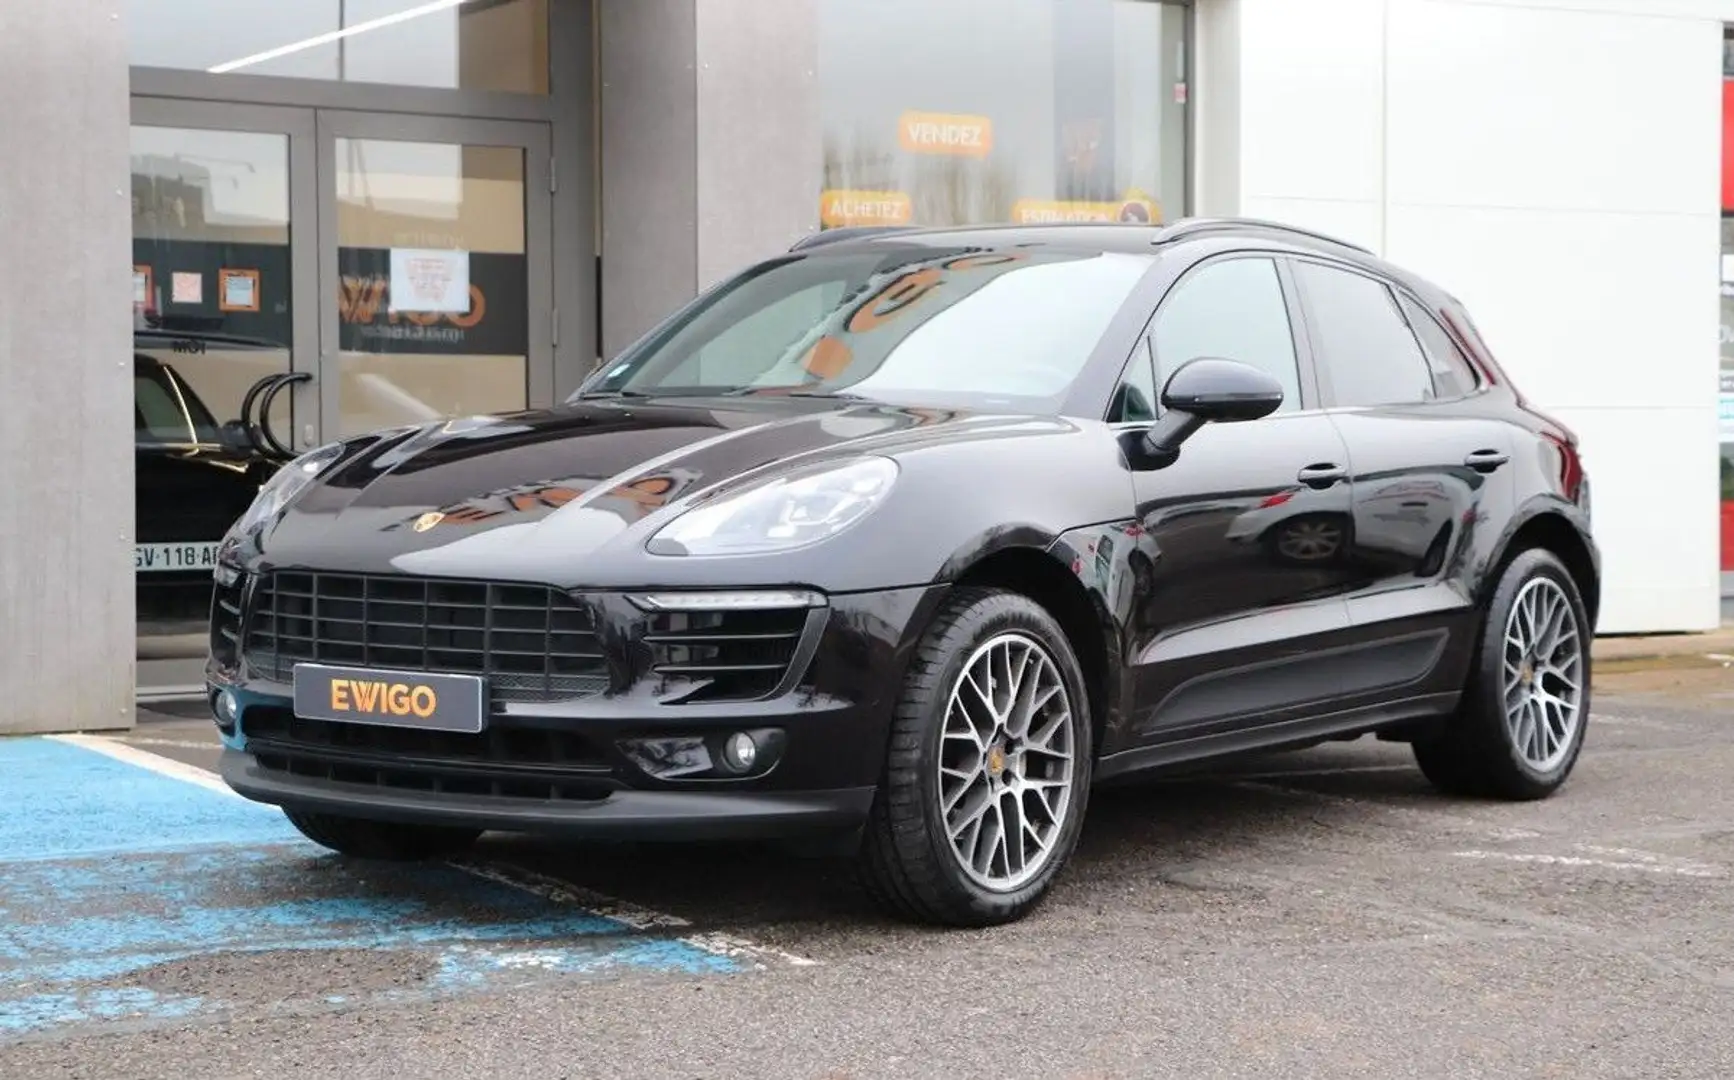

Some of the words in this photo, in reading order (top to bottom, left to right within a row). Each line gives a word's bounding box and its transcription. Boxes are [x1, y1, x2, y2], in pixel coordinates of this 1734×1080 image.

[907, 121, 982, 147] VENDEZ
[830, 199, 903, 219] ACHETEZ
[331, 678, 437, 718] EWIGO
